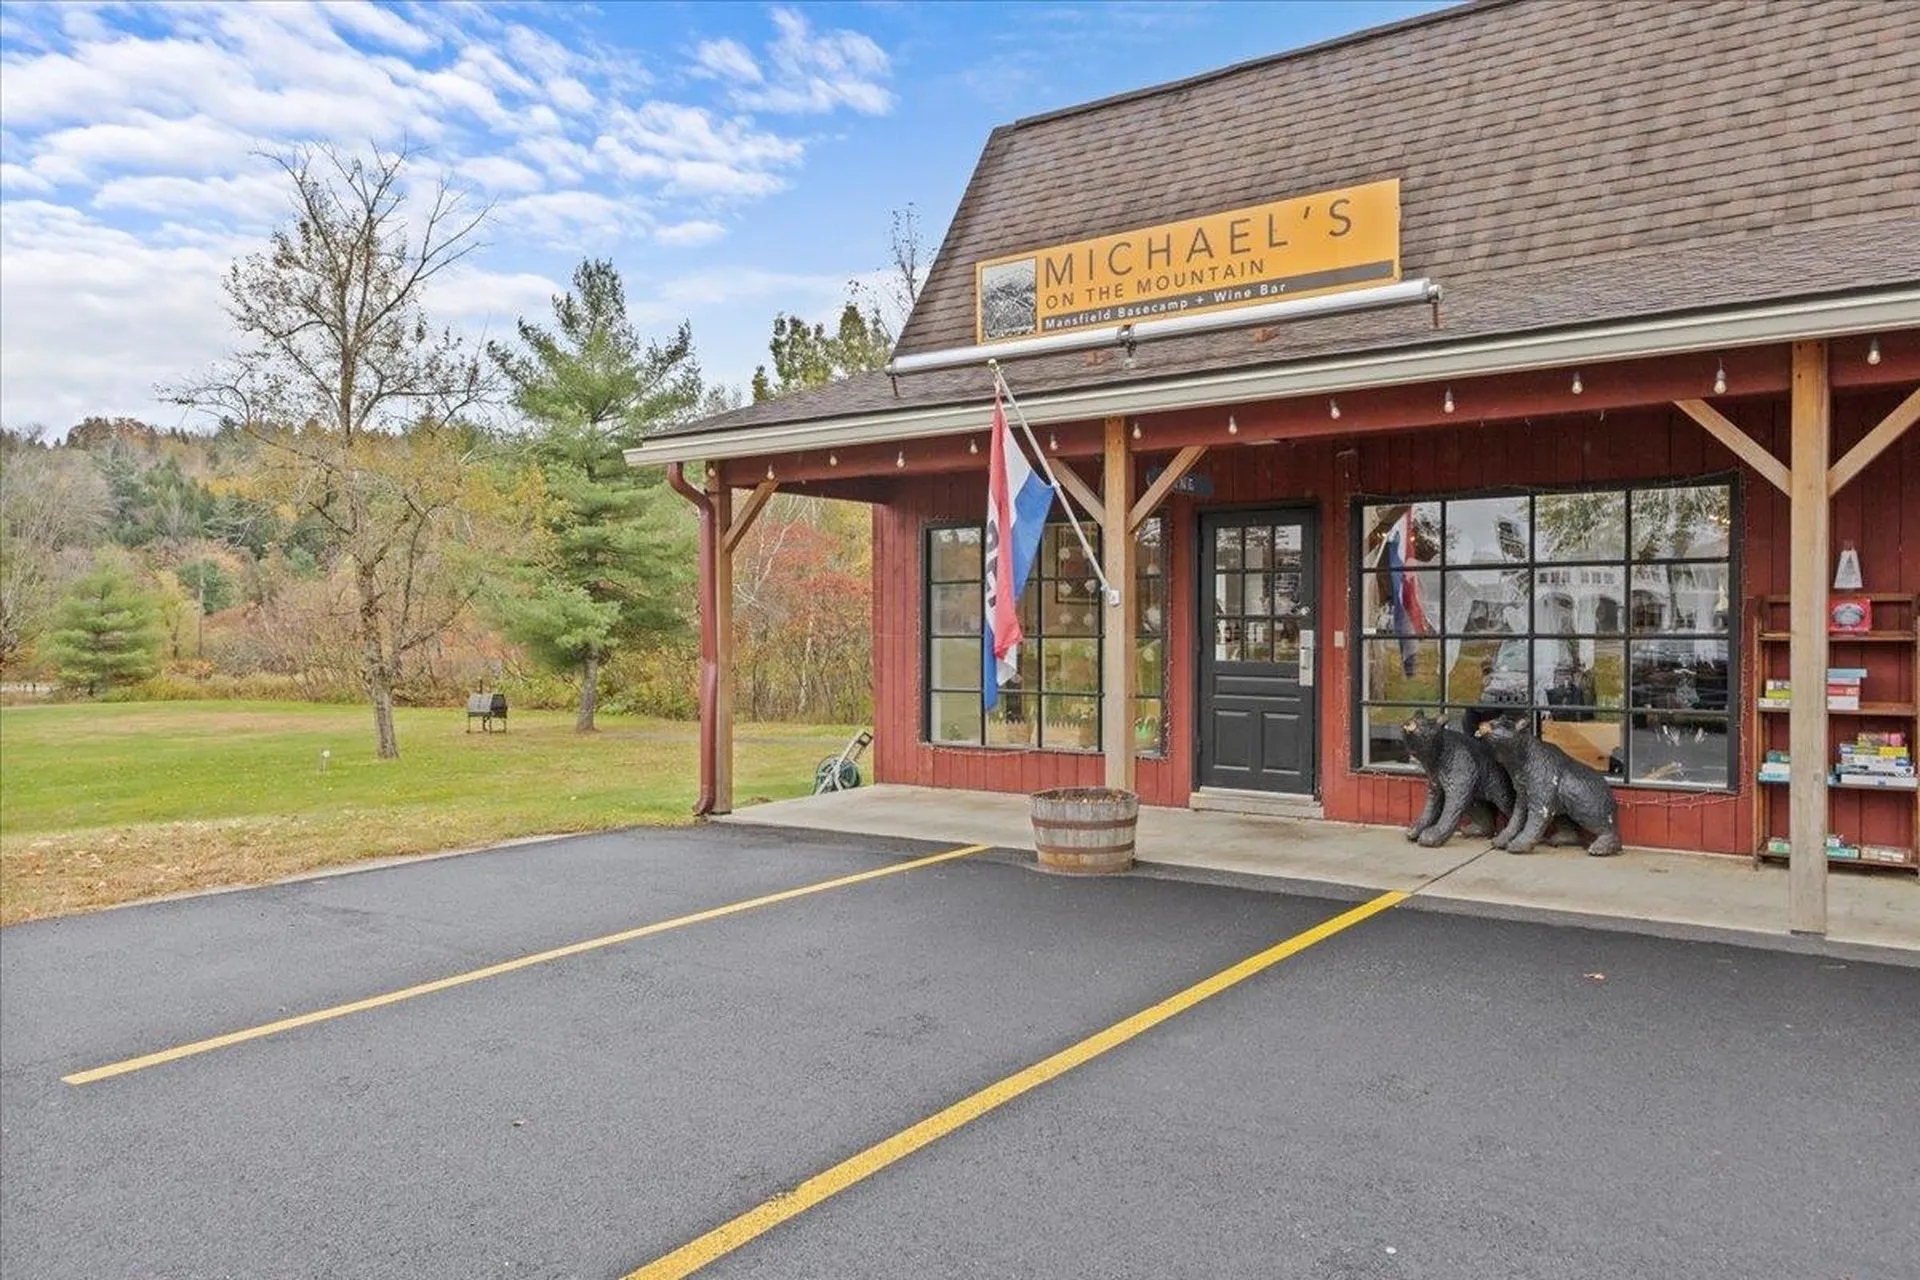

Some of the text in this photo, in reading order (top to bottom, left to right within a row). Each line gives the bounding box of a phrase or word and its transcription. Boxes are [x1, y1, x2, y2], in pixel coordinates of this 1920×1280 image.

[1045, 198, 1352, 288] MICHAEL'S
[1045, 259, 1264, 310] ON THE MOUNTAIN
[1045, 309, 1112, 330] Mansfield
[1117, 299, 1188, 318] Basecamp
[1214, 289, 1251, 303] Wine
[1259, 283, 1286, 297] Bar
